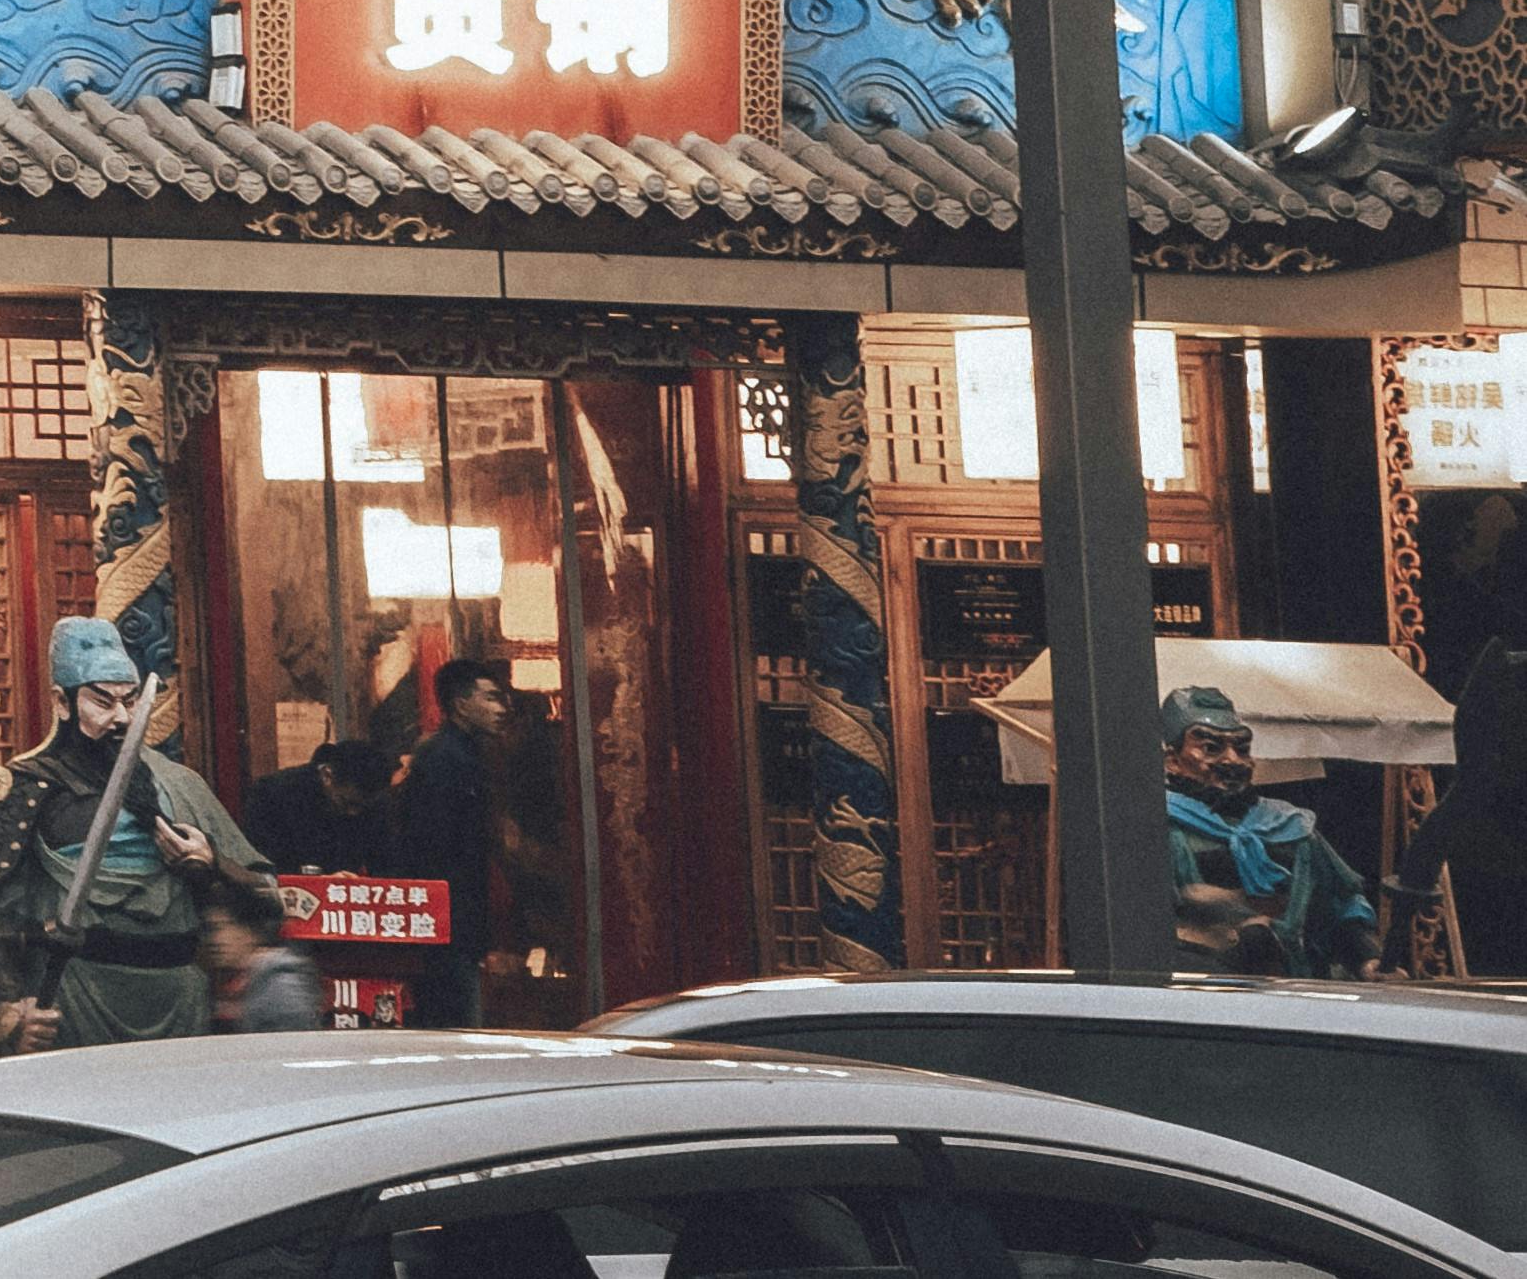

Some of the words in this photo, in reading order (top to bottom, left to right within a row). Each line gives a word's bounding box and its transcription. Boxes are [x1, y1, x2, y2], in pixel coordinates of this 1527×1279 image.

[326, 884, 428, 906] 每晚7点半
[321, 910, 437, 937] 川剧变脸
